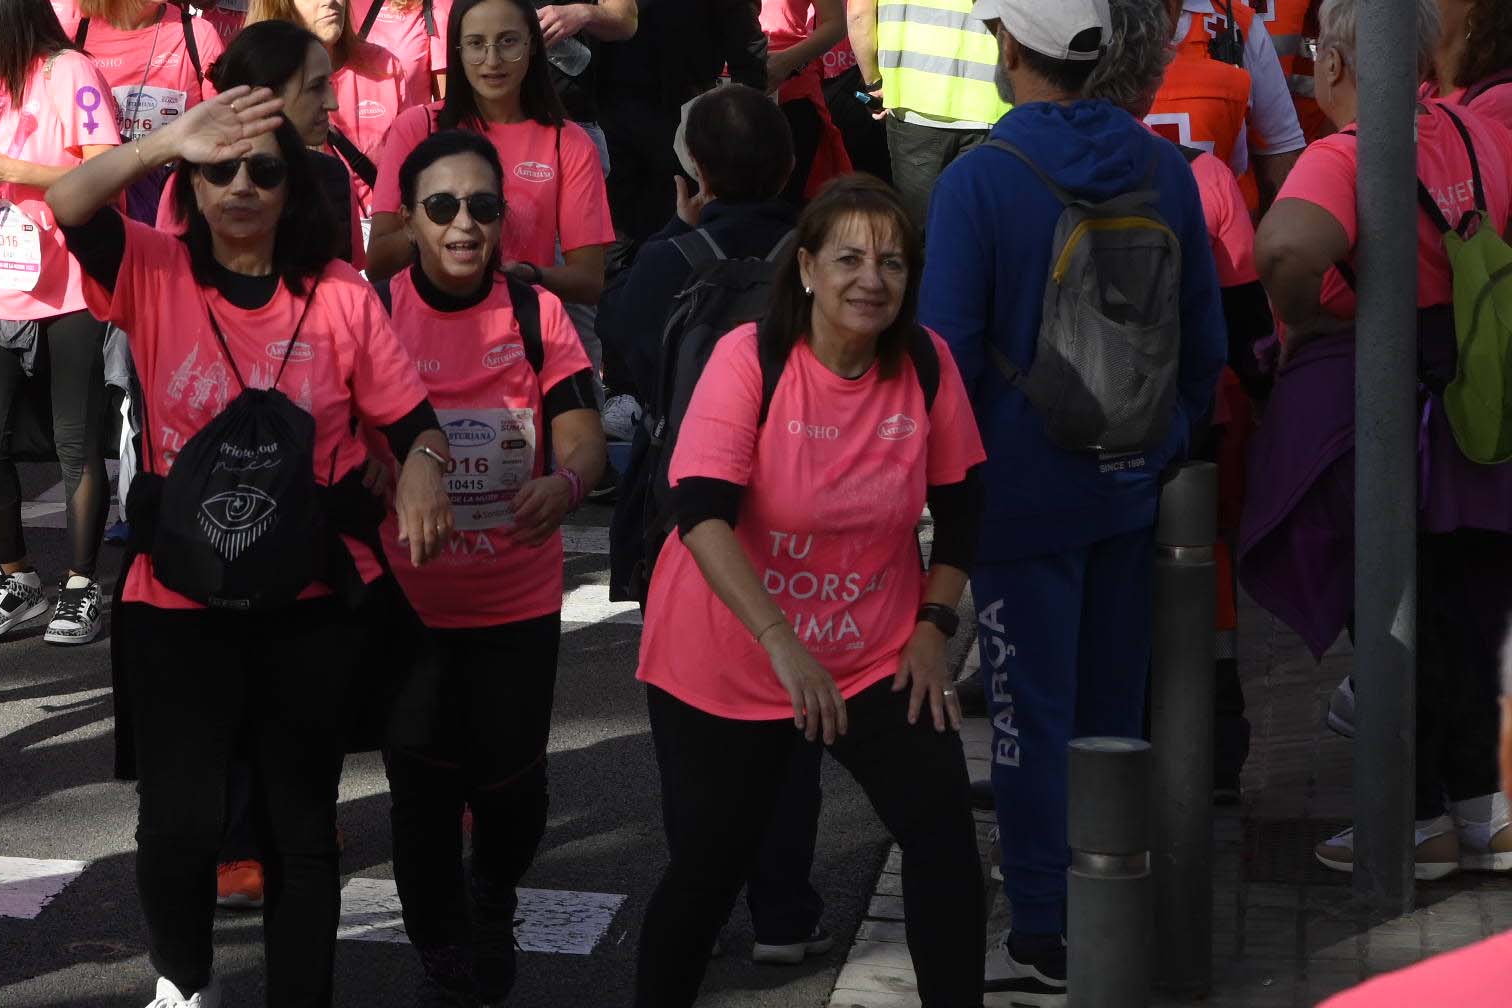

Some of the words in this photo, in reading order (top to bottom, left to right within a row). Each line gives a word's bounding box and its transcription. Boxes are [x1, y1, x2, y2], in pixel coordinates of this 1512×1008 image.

[94, 57, 122, 68] YSHO
[124, 118, 152, 130] 016
[448, 431, 492, 441] STURIANA
[446, 457, 489, 474] 016
[448, 479, 484, 490] 10415
[769, 530, 813, 560] TU
[977, 598, 1021, 768] BARÇA
